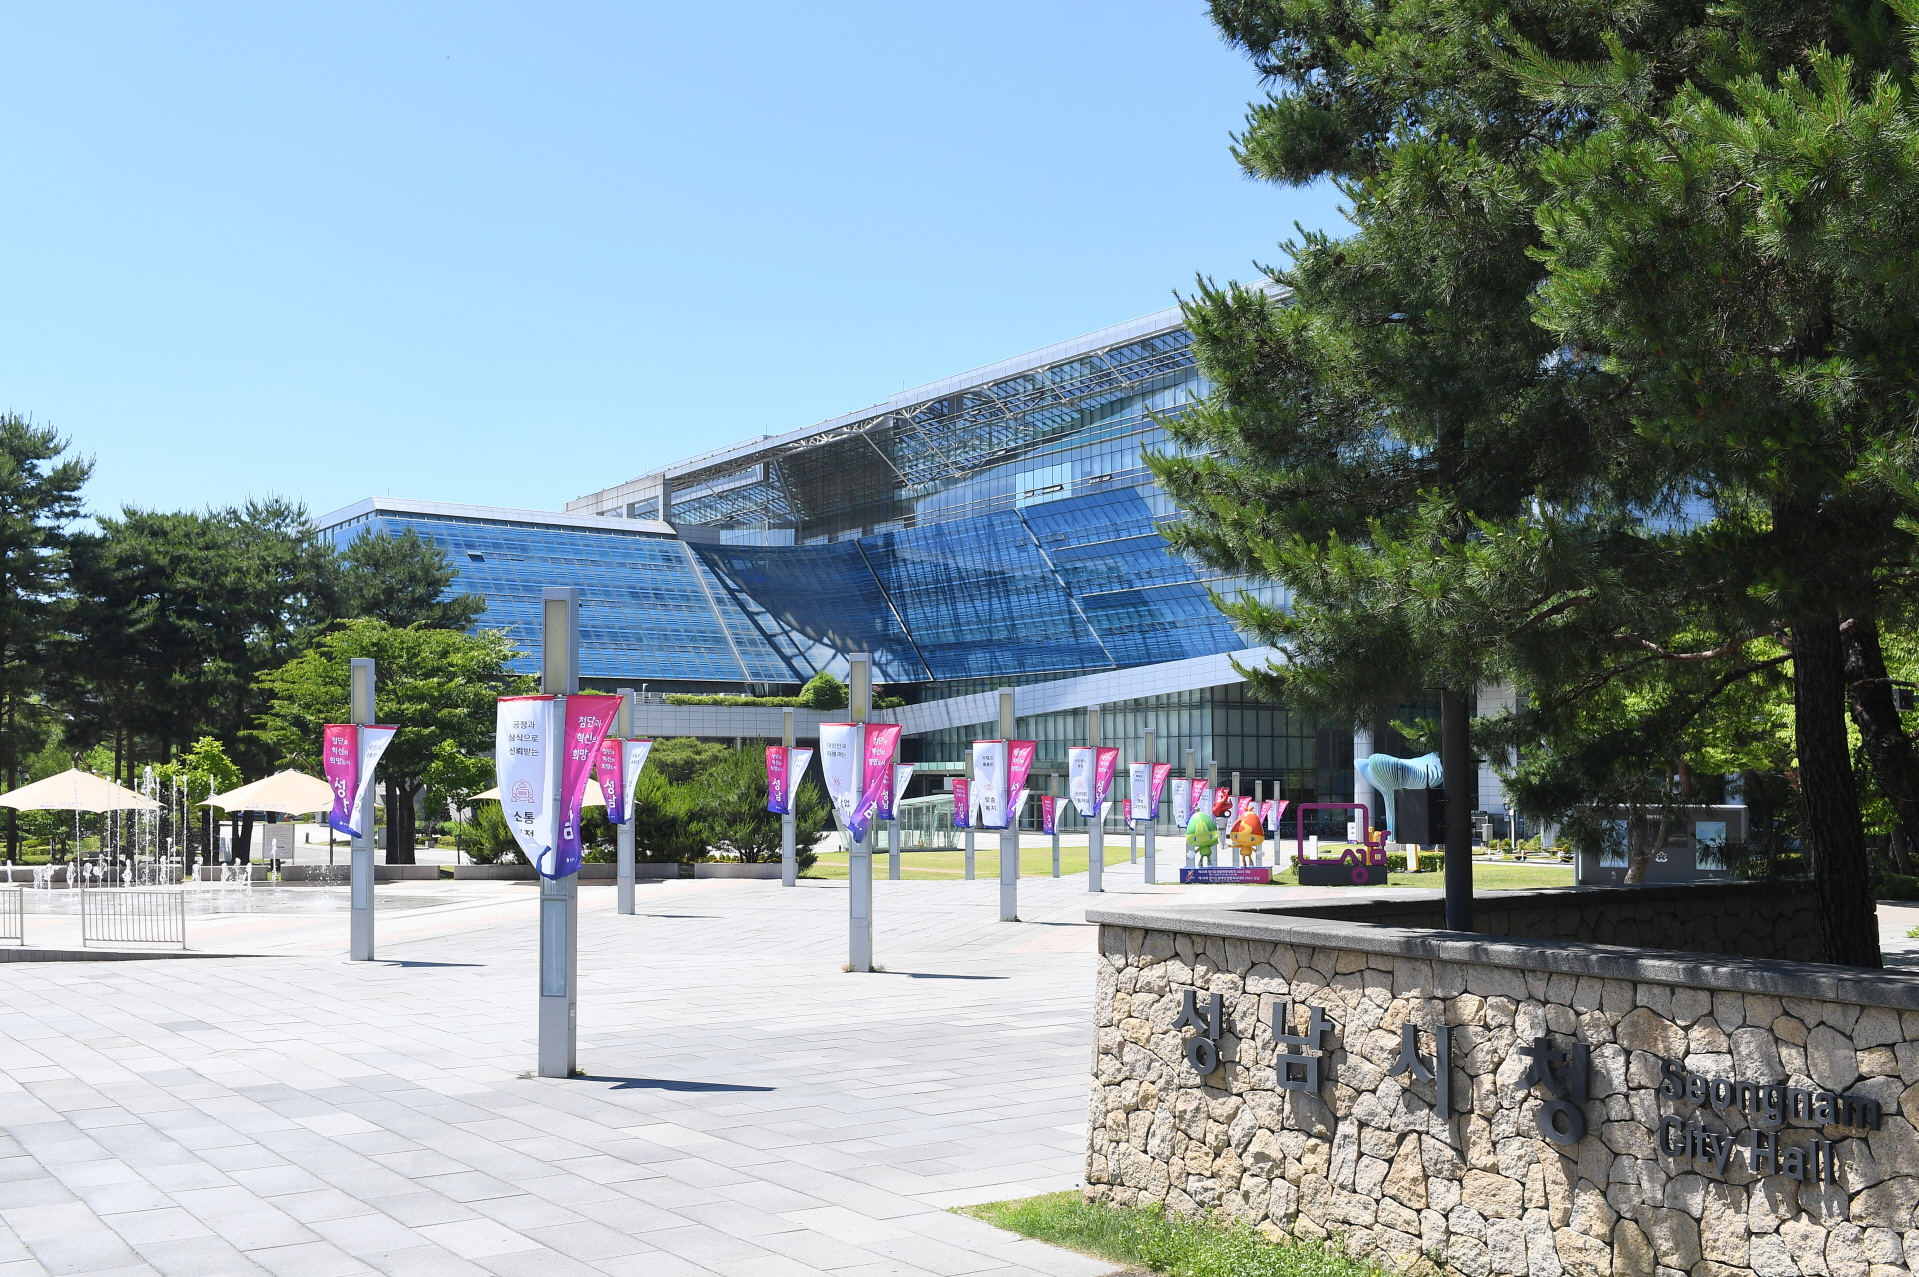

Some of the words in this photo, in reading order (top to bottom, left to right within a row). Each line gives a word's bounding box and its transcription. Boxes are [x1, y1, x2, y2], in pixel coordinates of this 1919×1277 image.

[512, 720, 536, 730] 공정과
[578, 715, 602, 729] 첨단과
[508, 733, 539, 743] 상식으로
[508, 747, 539, 757] 신뢰받는
[603, 778, 617, 809] 성남
[772, 778, 782, 802] 성남
[513, 811, 535, 825] 소통
[1172, 990, 1591, 1146] 성남시청
[1659, 1058, 1882, 1131] Seongnam
[1659, 1114, 1736, 1175] City
[1751, 1127, 1836, 1186] Hall
